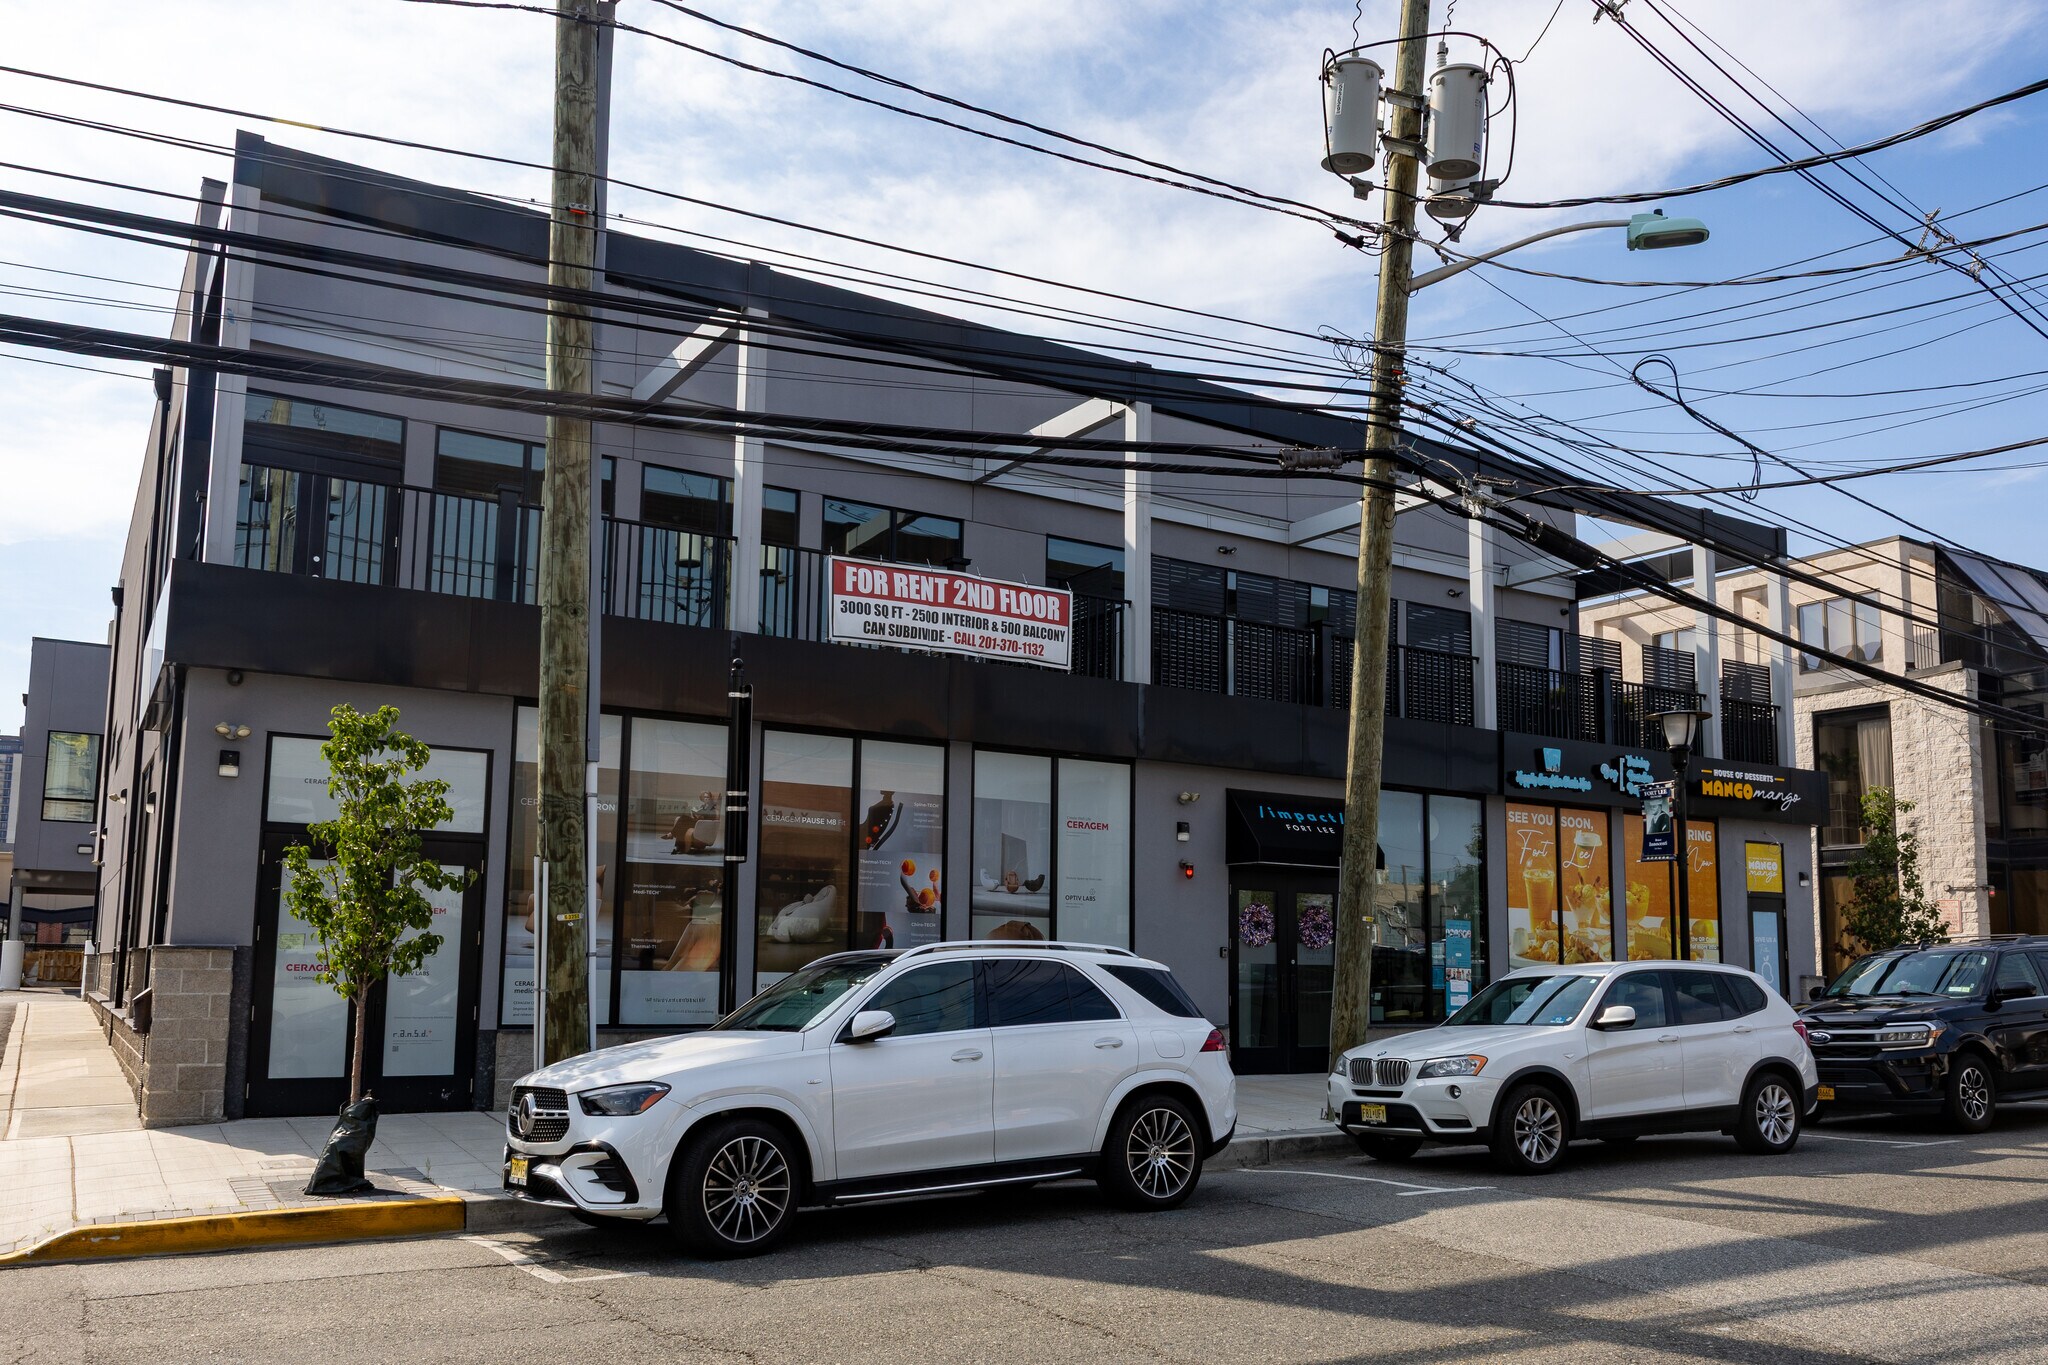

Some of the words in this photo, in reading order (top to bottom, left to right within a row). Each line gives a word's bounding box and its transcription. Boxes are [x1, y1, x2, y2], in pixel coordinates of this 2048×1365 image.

[845, 565, 889, 596] FOR
[893, 572, 949, 603] RENT
[953, 579, 995, 611] 2ND
[999, 587, 1060, 621] FLOOR
[840, 600, 872, 616] 3000
[874, 603, 889, 619] SQ
[891, 605, 904, 619] FT
[912, 608, 939, 624] 2500
[941, 612, 989, 631] INTERIOR
[991, 621, 999, 632] &
[1001, 621, 1021, 635] 500
[1023, 624, 1066, 642] BALCONY
[863, 620, 886, 636] CAN
[888, 623, 945, 643] SUBDIVIDE
[953, 631, 977, 647] CALL
[978, 635, 1045, 657] 201-370-1132
[1713, 768, 1734, 779] HOUSE
[1735, 771, 1744, 779] OF
[1744, 772, 1774, 783] DESSERTS
[1702, 779, 1753, 800] MANGO
[1753, 789, 1801, 811] mango
[766, 814, 800, 823] CERAGEM
[801, 816, 825, 825] PAUSE
[826, 818, 837, 826] M8
[1066, 820, 1109, 831] CERAGEM
[1285, 824, 1312, 832] FORT
[1317, 826, 1335, 834] LEE
[1508, 810, 1529, 824] SEE
[1530, 813, 1554, 826] YOU
[1560, 816, 1594, 831] SOON,
[1516, 829, 1554, 865] Fort
[1562, 831, 1597, 868] Lee!
[1748, 860, 1778, 871] MANGO
[1748, 870, 1778, 883] mango
